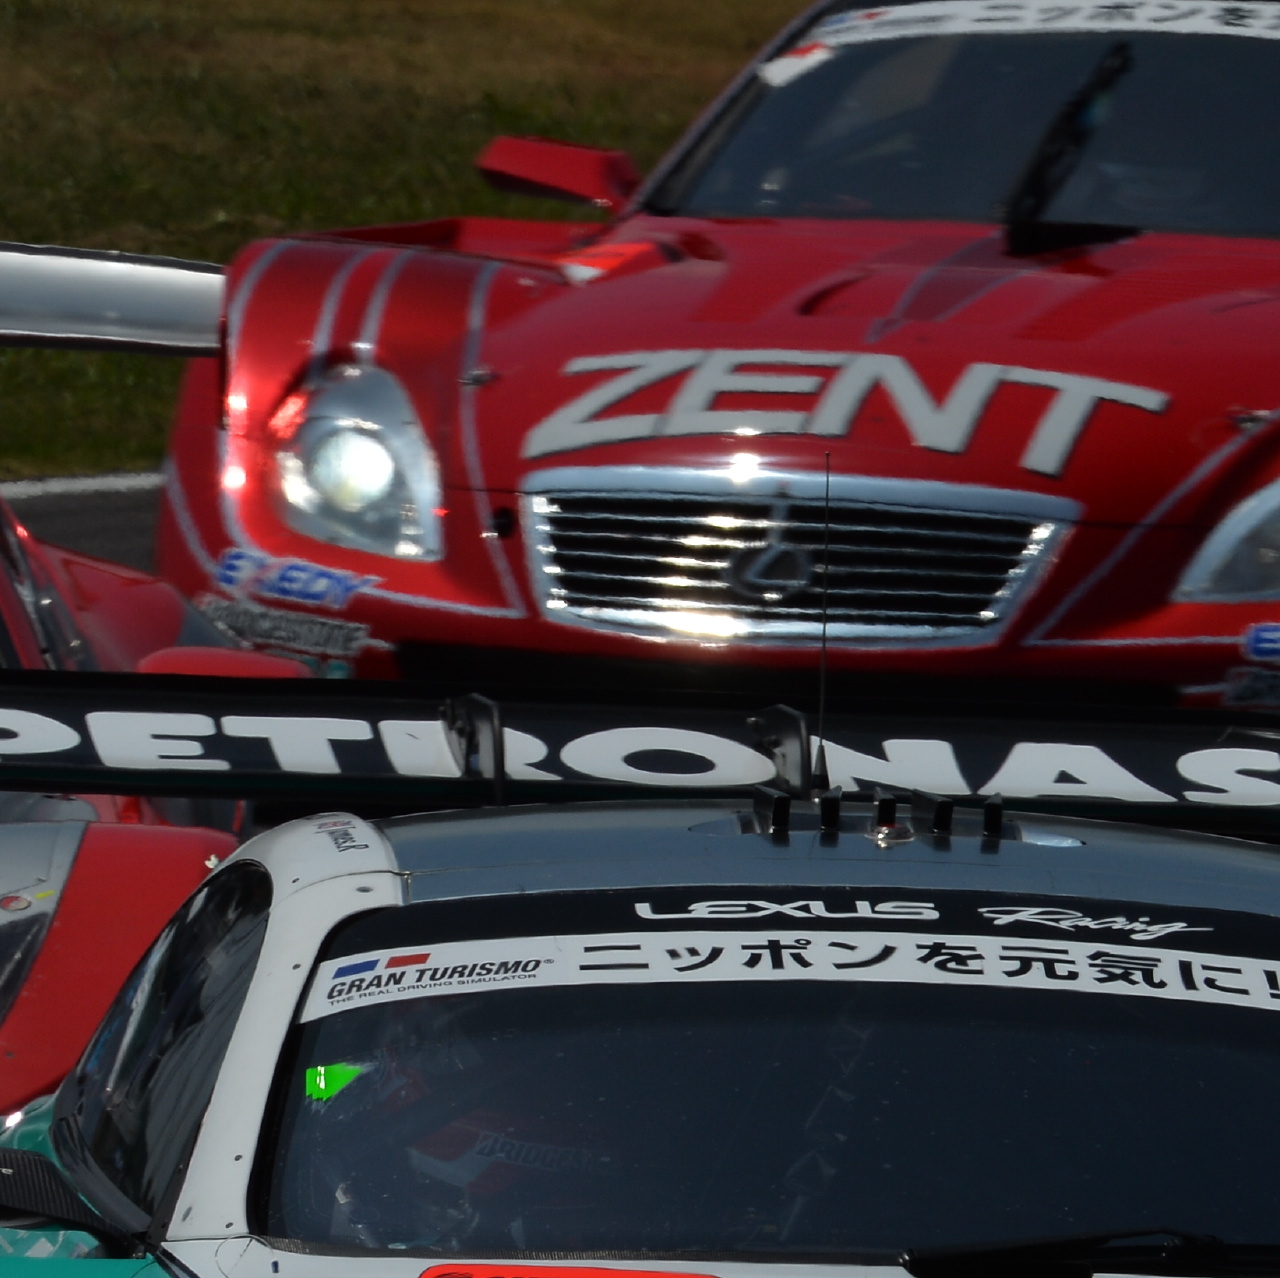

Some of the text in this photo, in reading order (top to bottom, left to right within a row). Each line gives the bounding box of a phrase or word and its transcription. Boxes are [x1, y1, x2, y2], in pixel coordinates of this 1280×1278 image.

[522, 348, 1172, 478] ZENT
[634, 900, 1215, 940] LEXUS Racing
[326, 971, 407, 1000] GRAN
[328, 974, 538, 1007] THE REAL DRIVING SIMULATOR
